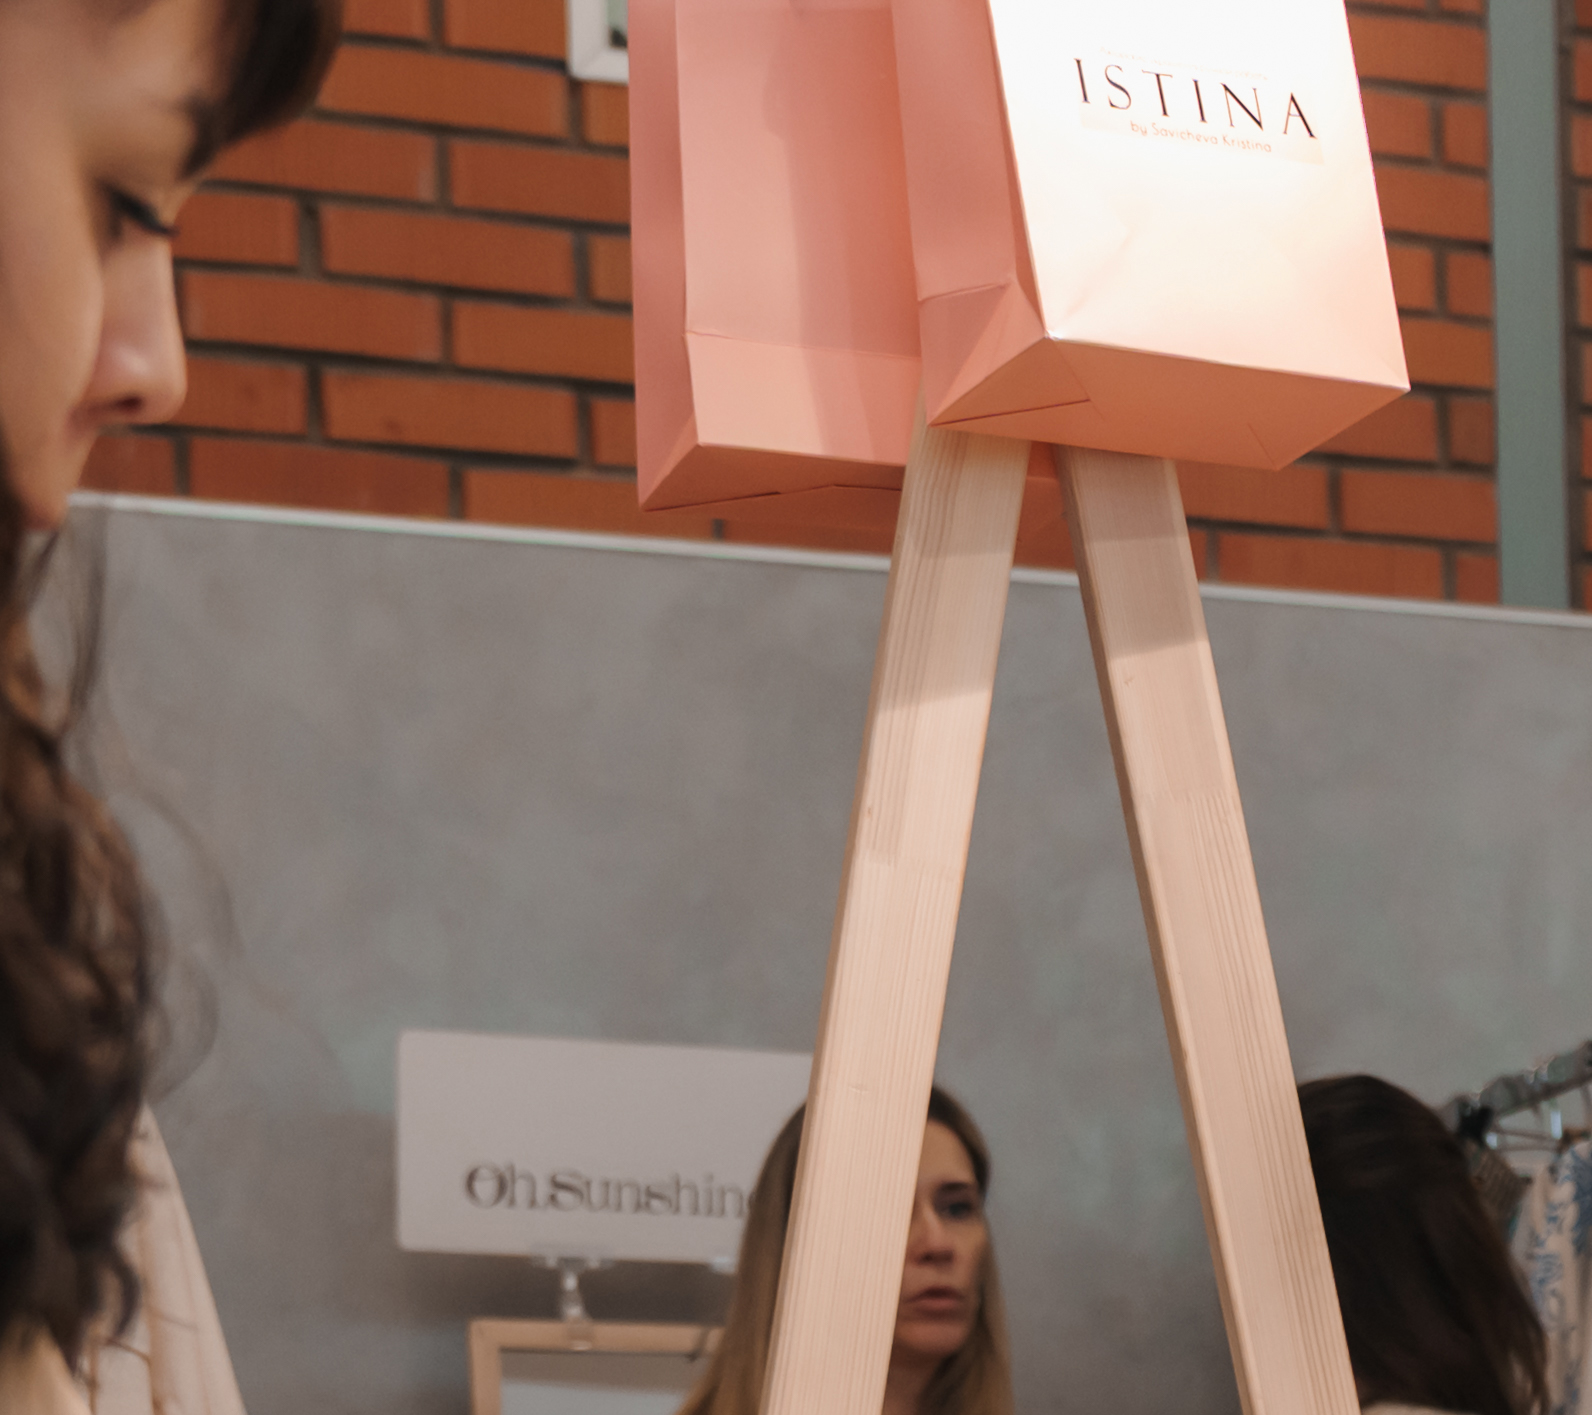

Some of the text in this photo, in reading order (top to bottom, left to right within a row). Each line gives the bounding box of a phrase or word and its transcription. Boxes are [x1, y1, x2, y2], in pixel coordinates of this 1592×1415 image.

[1073, 57, 1318, 140] ISTINA
[1130, 119, 1273, 154] by Savicheva Kristina
[465, 1162, 756, 1219] Oh.Sunshin
